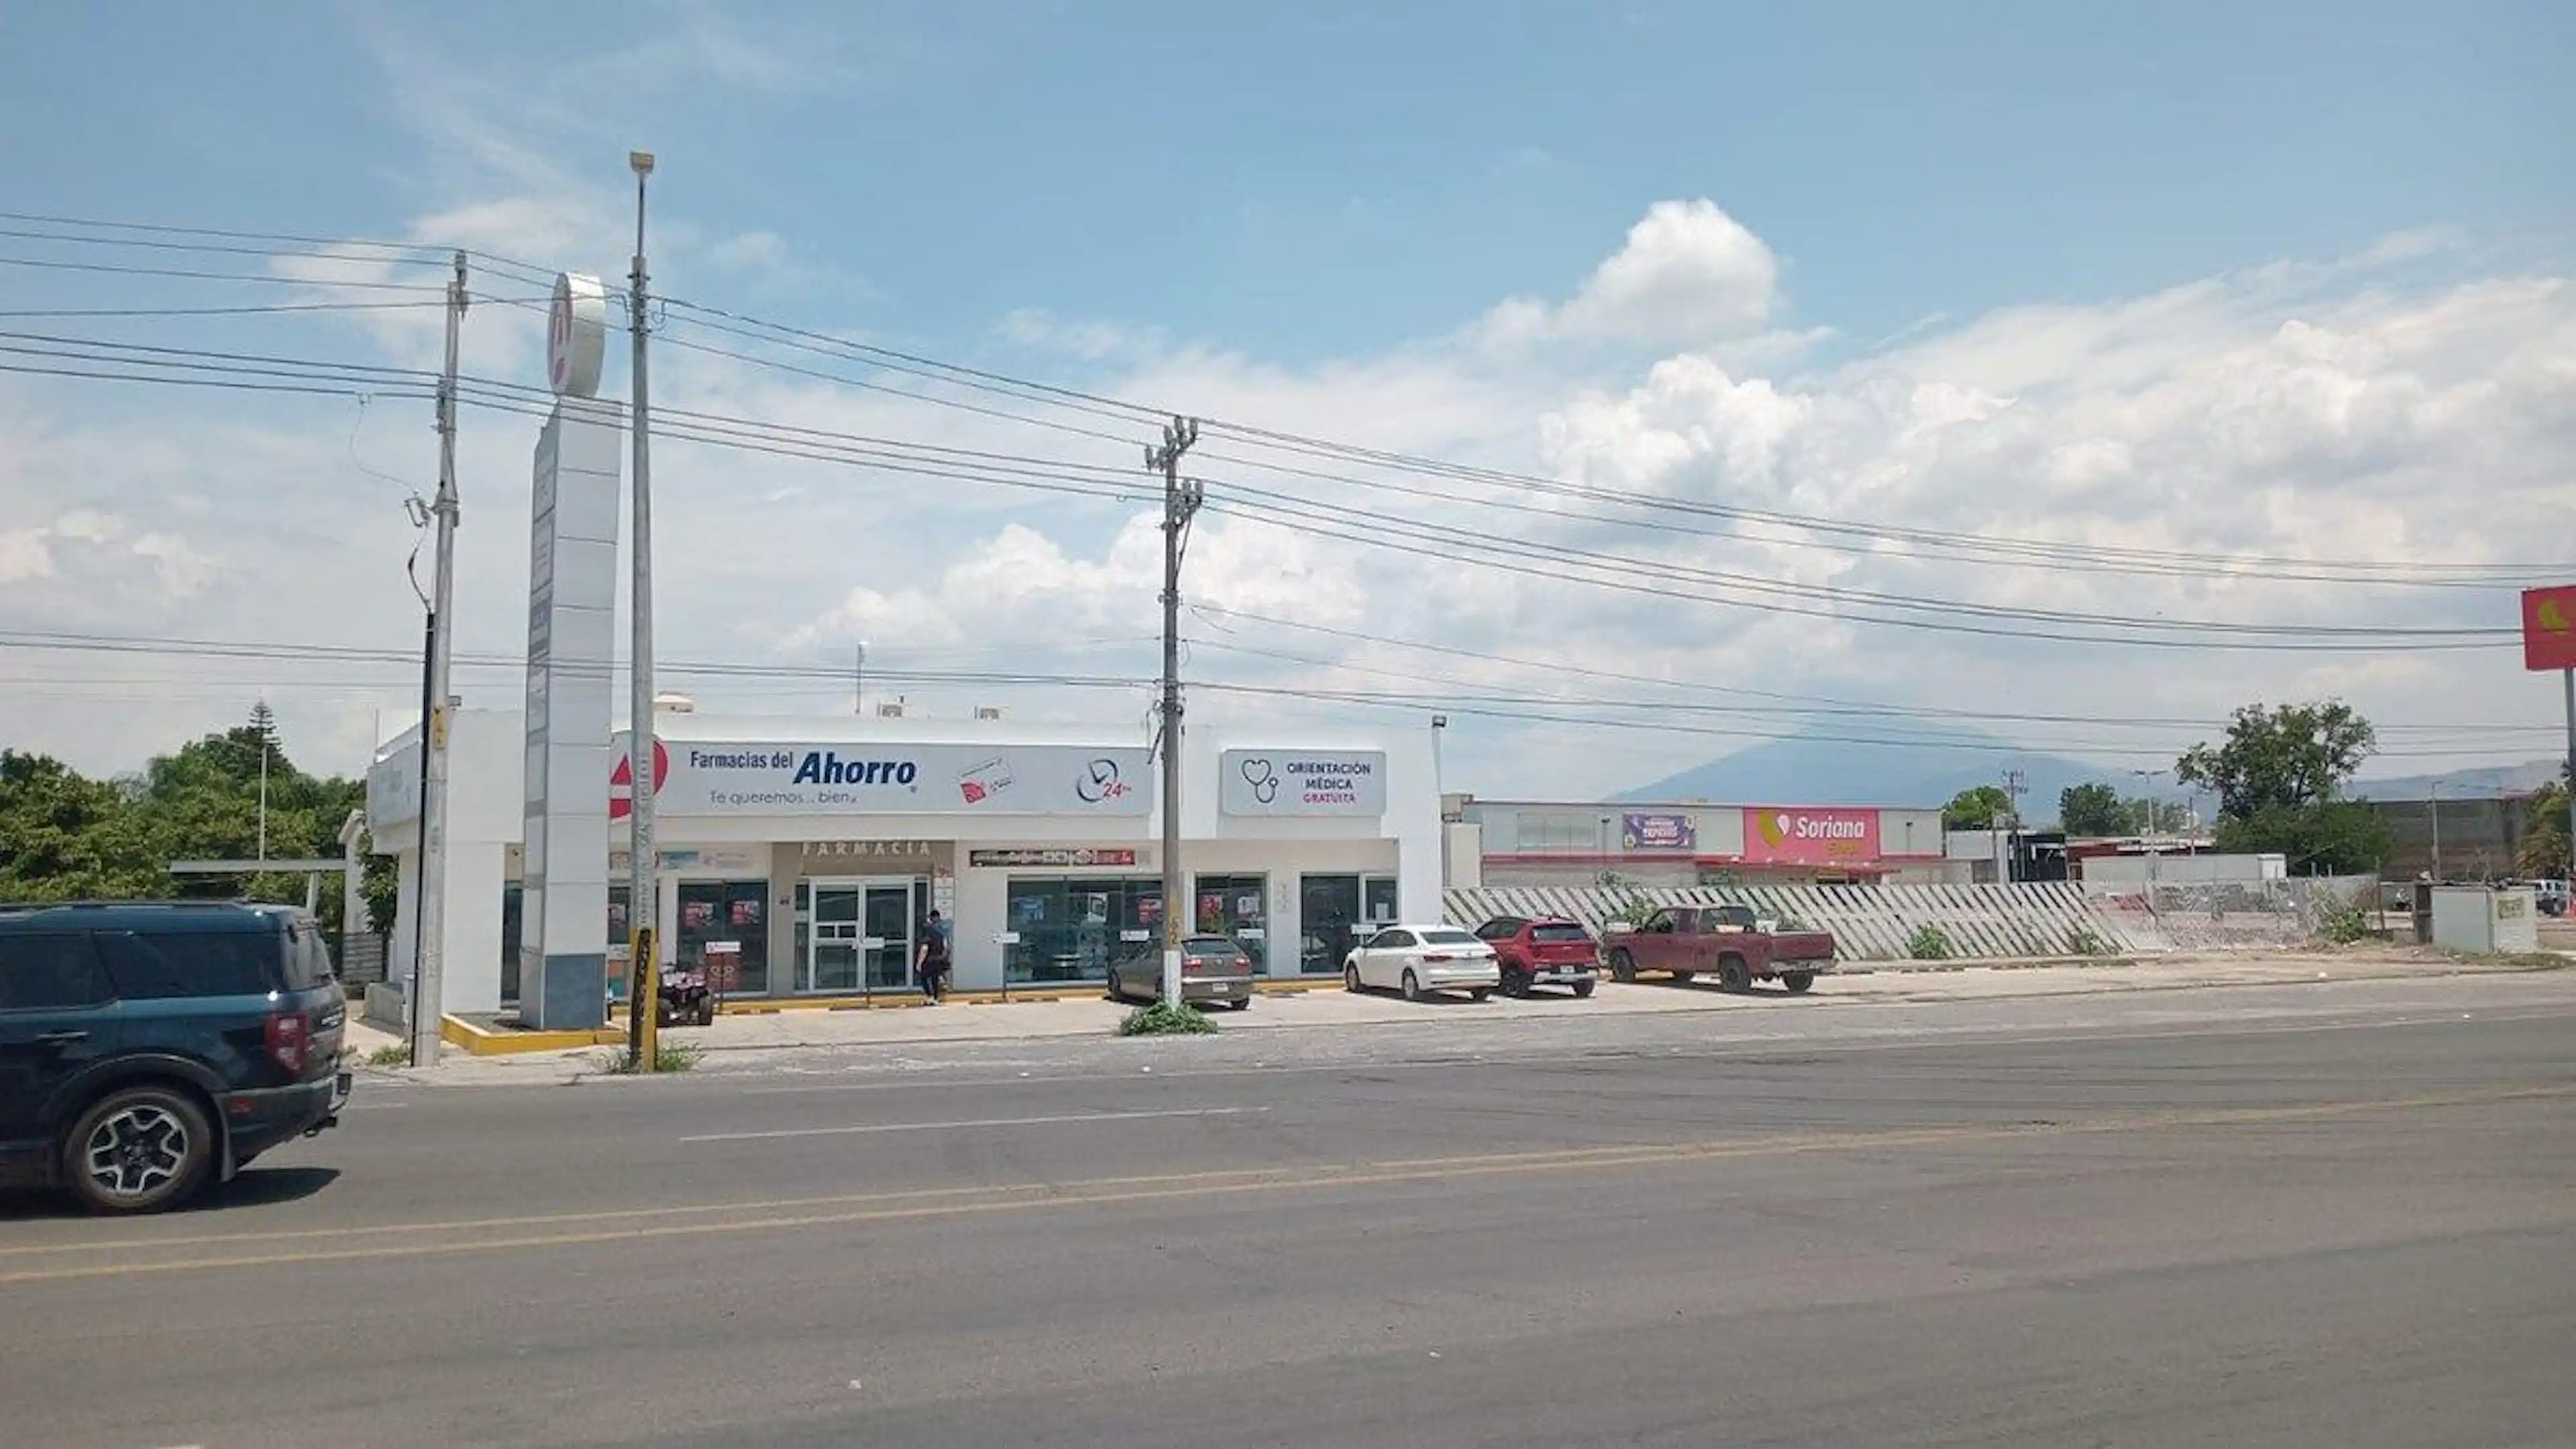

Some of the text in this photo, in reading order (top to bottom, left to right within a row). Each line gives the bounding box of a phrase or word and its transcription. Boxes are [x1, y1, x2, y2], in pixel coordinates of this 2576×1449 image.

[690, 751, 917, 784] Farmacias del Ahorro
[1287, 761, 1371, 775] ORIENTACIÓN
[710, 790, 726, 804] Te
[1303, 792, 1355, 804] GRATUITA
[1795, 814, 1865, 839] Soriana
[801, 841, 932, 857] FARMACIA
